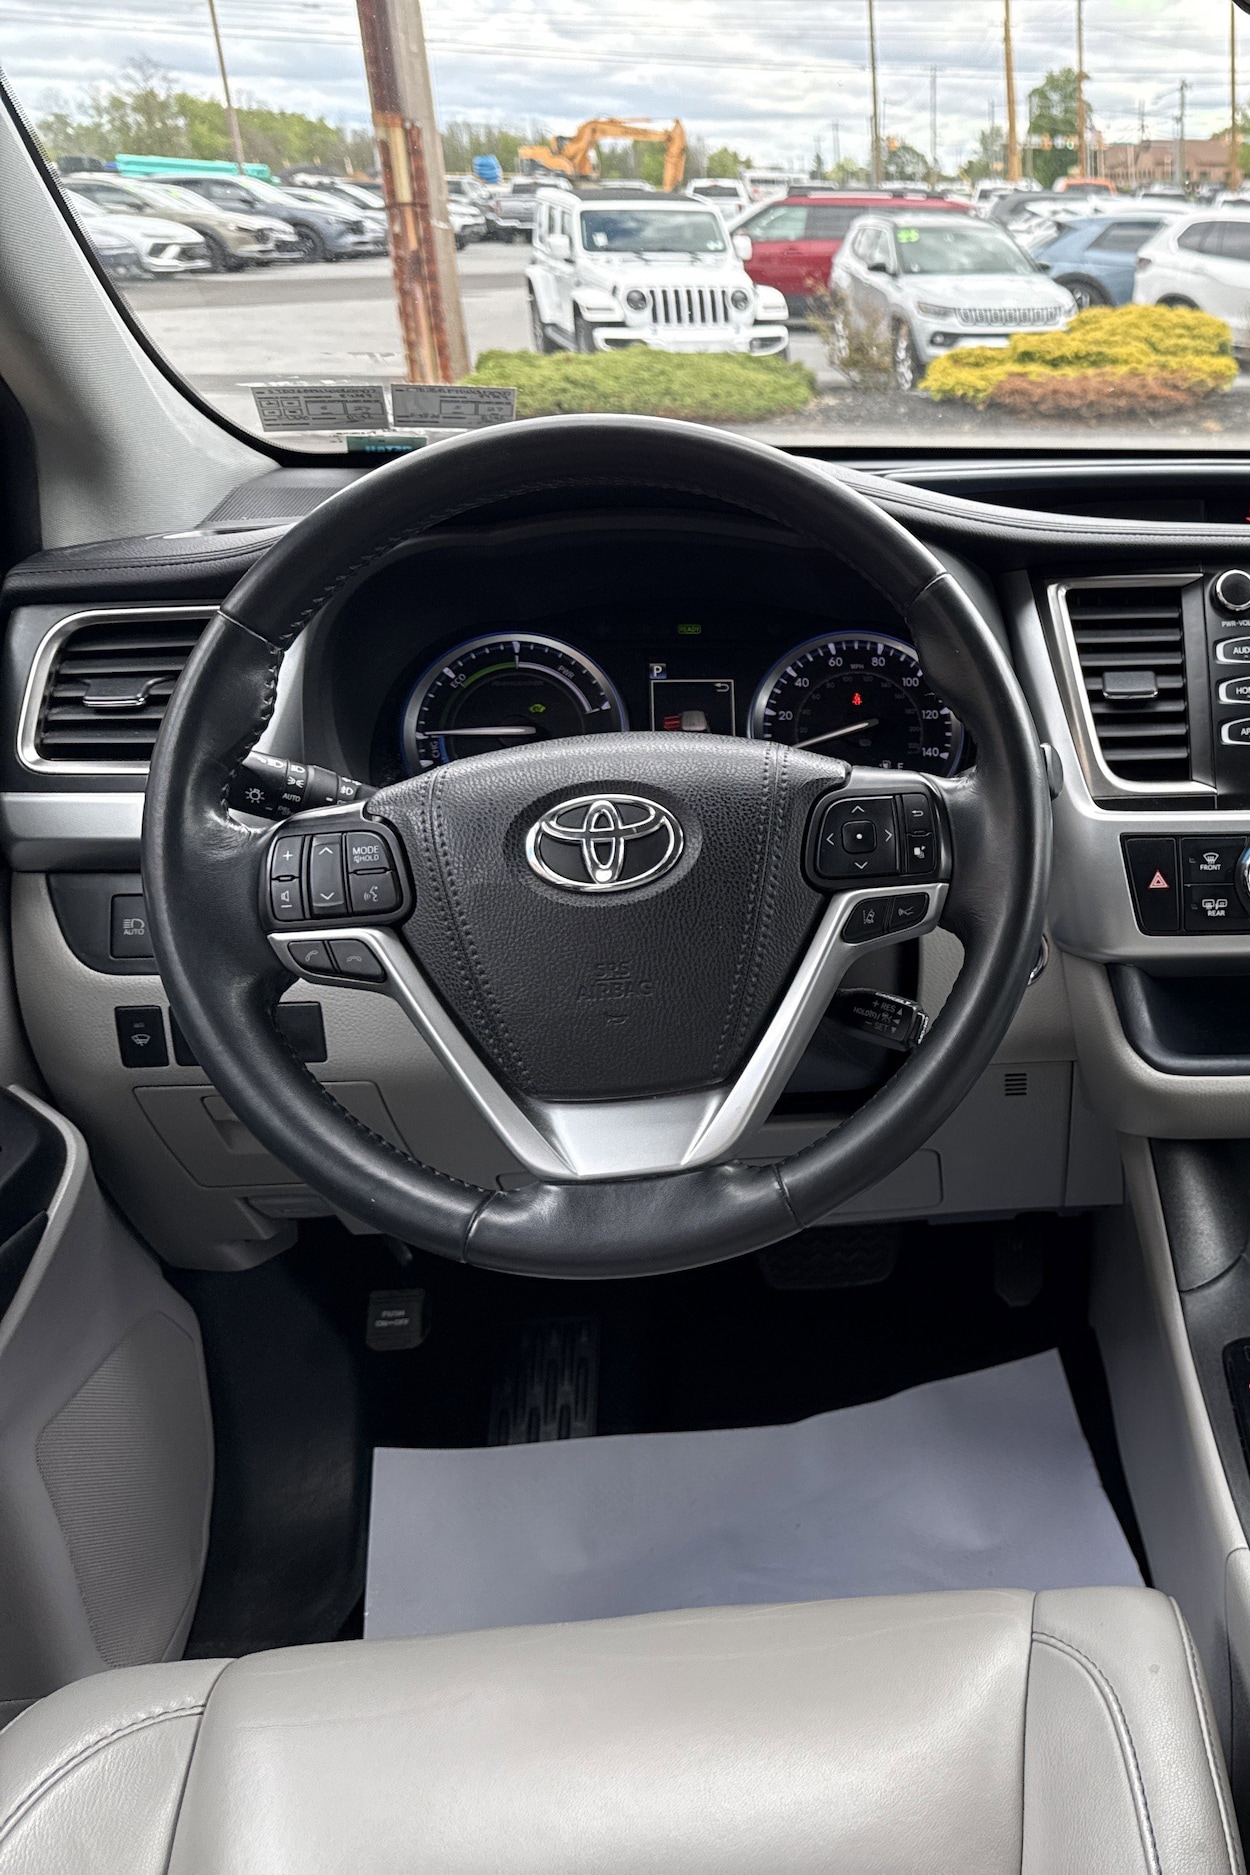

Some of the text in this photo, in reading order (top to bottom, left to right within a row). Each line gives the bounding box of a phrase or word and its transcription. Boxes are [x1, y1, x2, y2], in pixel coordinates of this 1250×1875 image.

[828, 656, 843, 667] 60
[871, 656, 886, 667] 80
[557, 664, 575, 679] PWR
[653, 666, 664, 676] P
[450, 673, 466, 689] ECO
[794, 677, 810, 688] 40
[902, 677, 920, 688] 100
[778, 710, 794, 721] 20
[922, 710, 939, 720] 120
[430, 740, 440, 758] CHG
[922, 747, 940, 757] 140
[282, 793, 302, 803] AUTO
[352, 846, 380, 855] MODE
[360, 854, 380, 862] HOLD
[1208, 909, 1226, 917] REAR
[123, 928, 145, 936] AUTO
[880, 1002, 896, 1014] RES
[874, 1022, 890, 1032] SET
